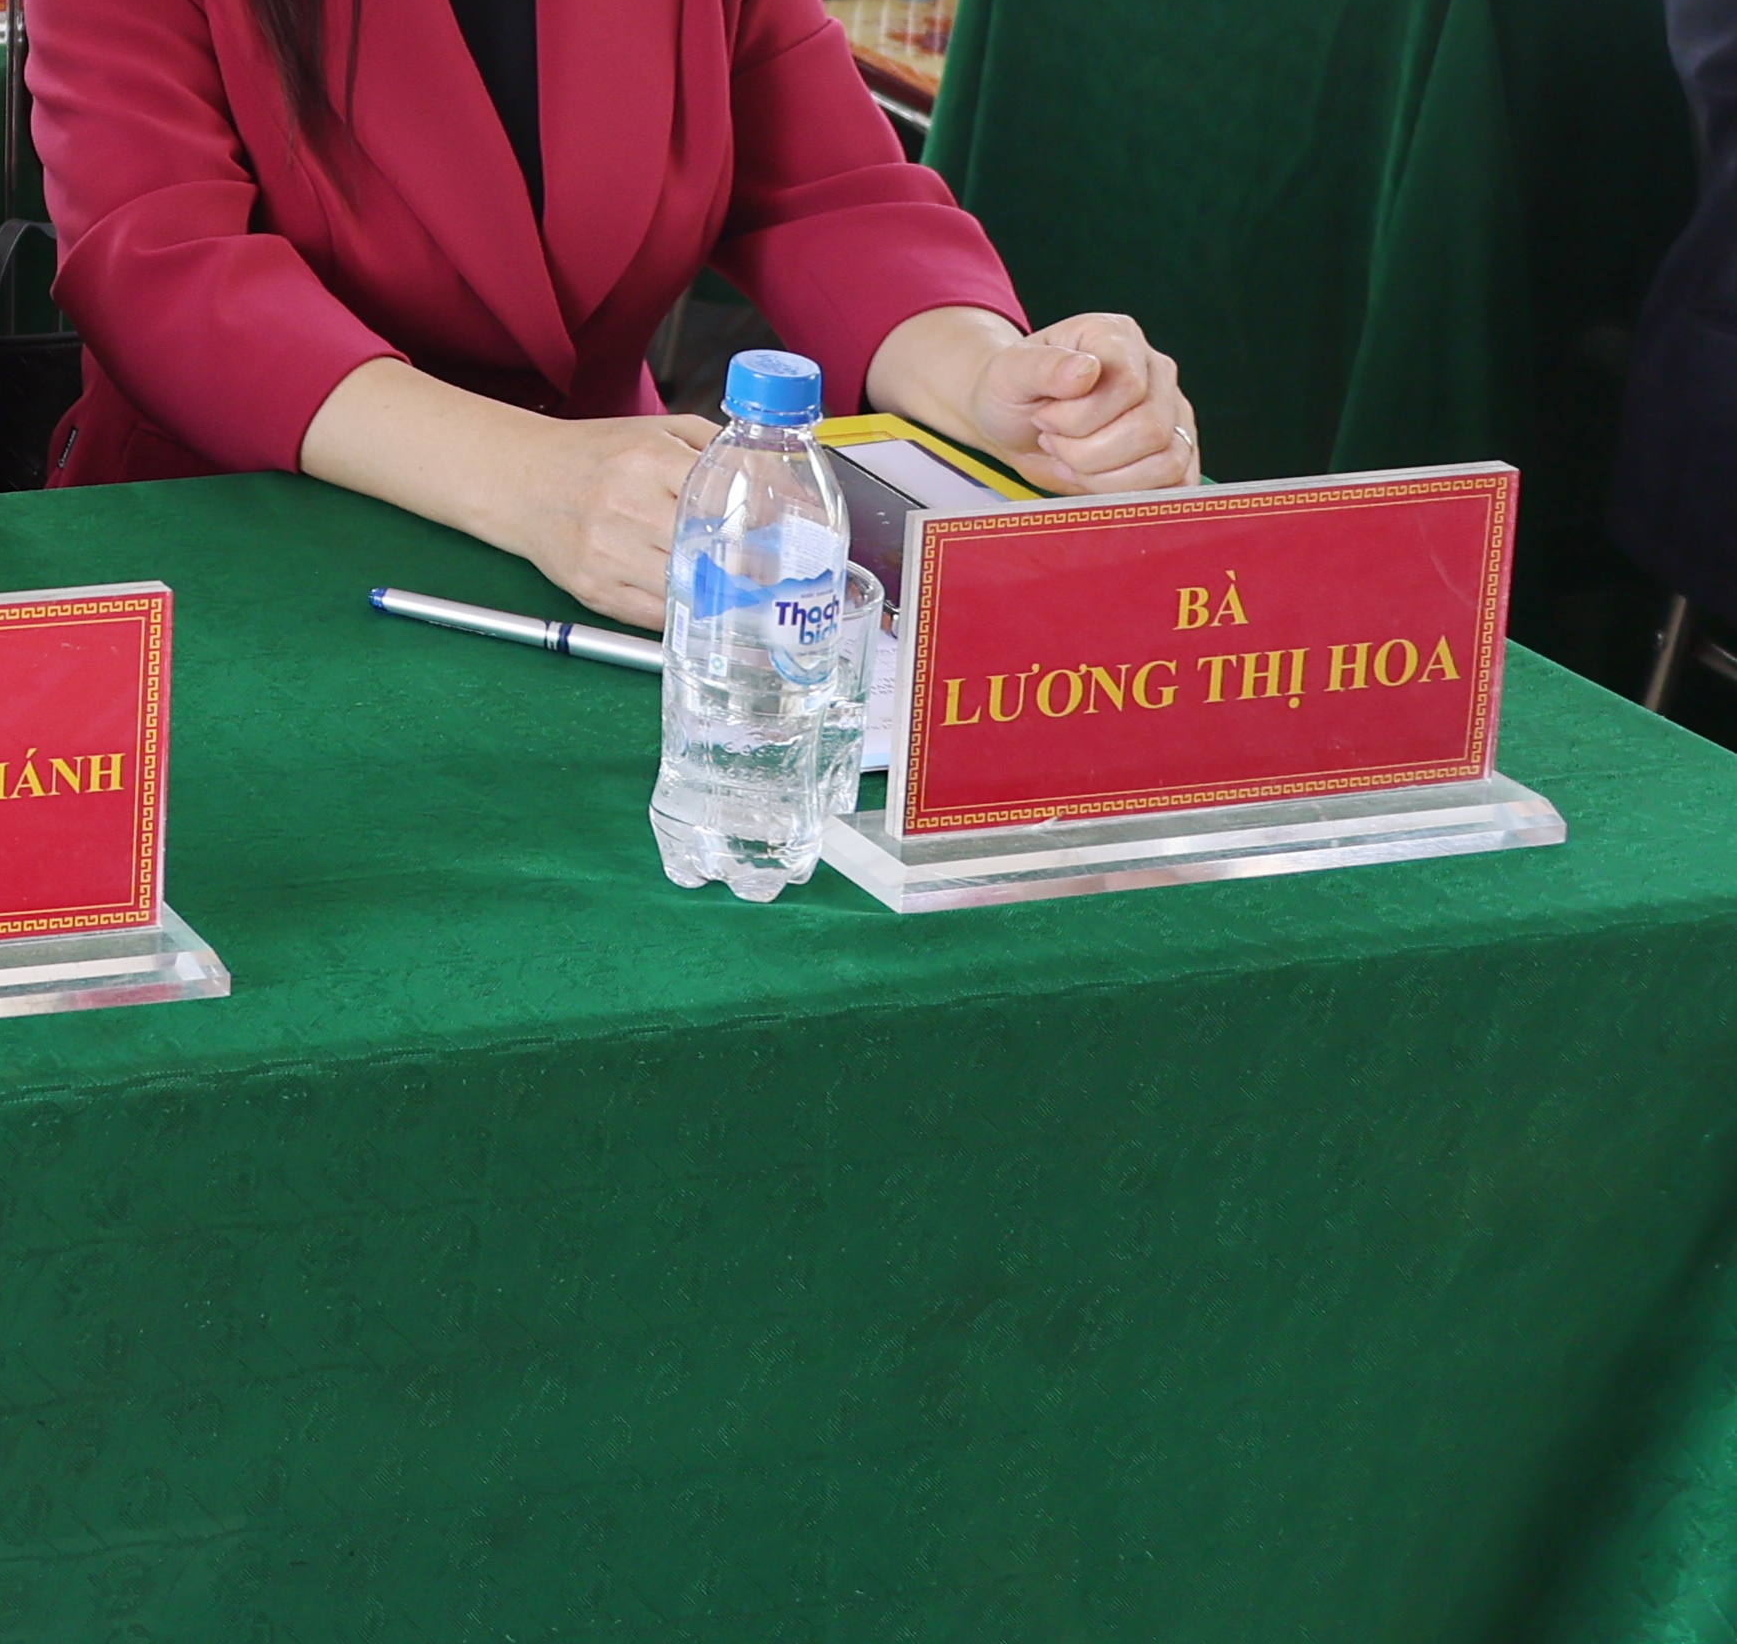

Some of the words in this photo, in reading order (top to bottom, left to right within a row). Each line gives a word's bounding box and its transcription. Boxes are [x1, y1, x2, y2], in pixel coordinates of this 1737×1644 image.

[1173, 570, 1250, 632] BÀ
[941, 660, 1179, 729] LƯƠNG
[1195, 647, 1308, 709] THỊ
[1327, 635, 1462, 692] HOA
